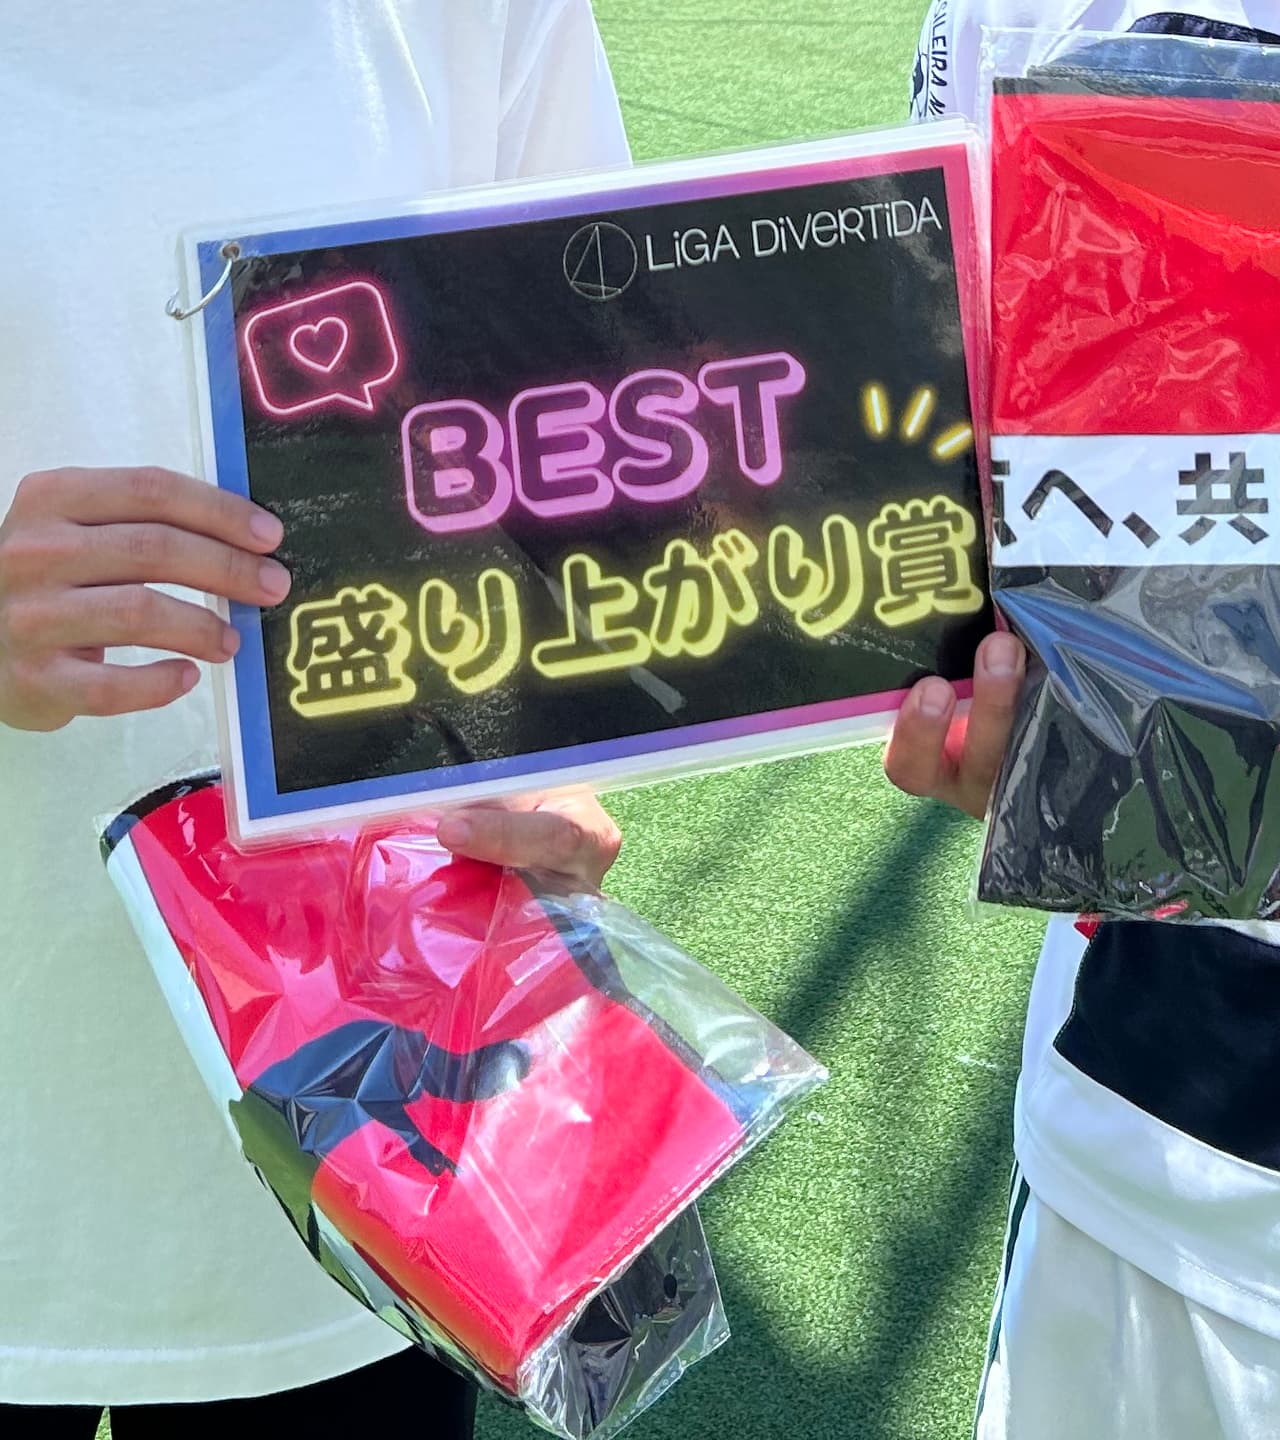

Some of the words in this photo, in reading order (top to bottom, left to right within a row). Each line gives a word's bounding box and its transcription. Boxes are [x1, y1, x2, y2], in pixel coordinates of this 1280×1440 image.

[402, 352, 805, 534] BEST
[287, 495, 983, 718] 盛り上がり賞
